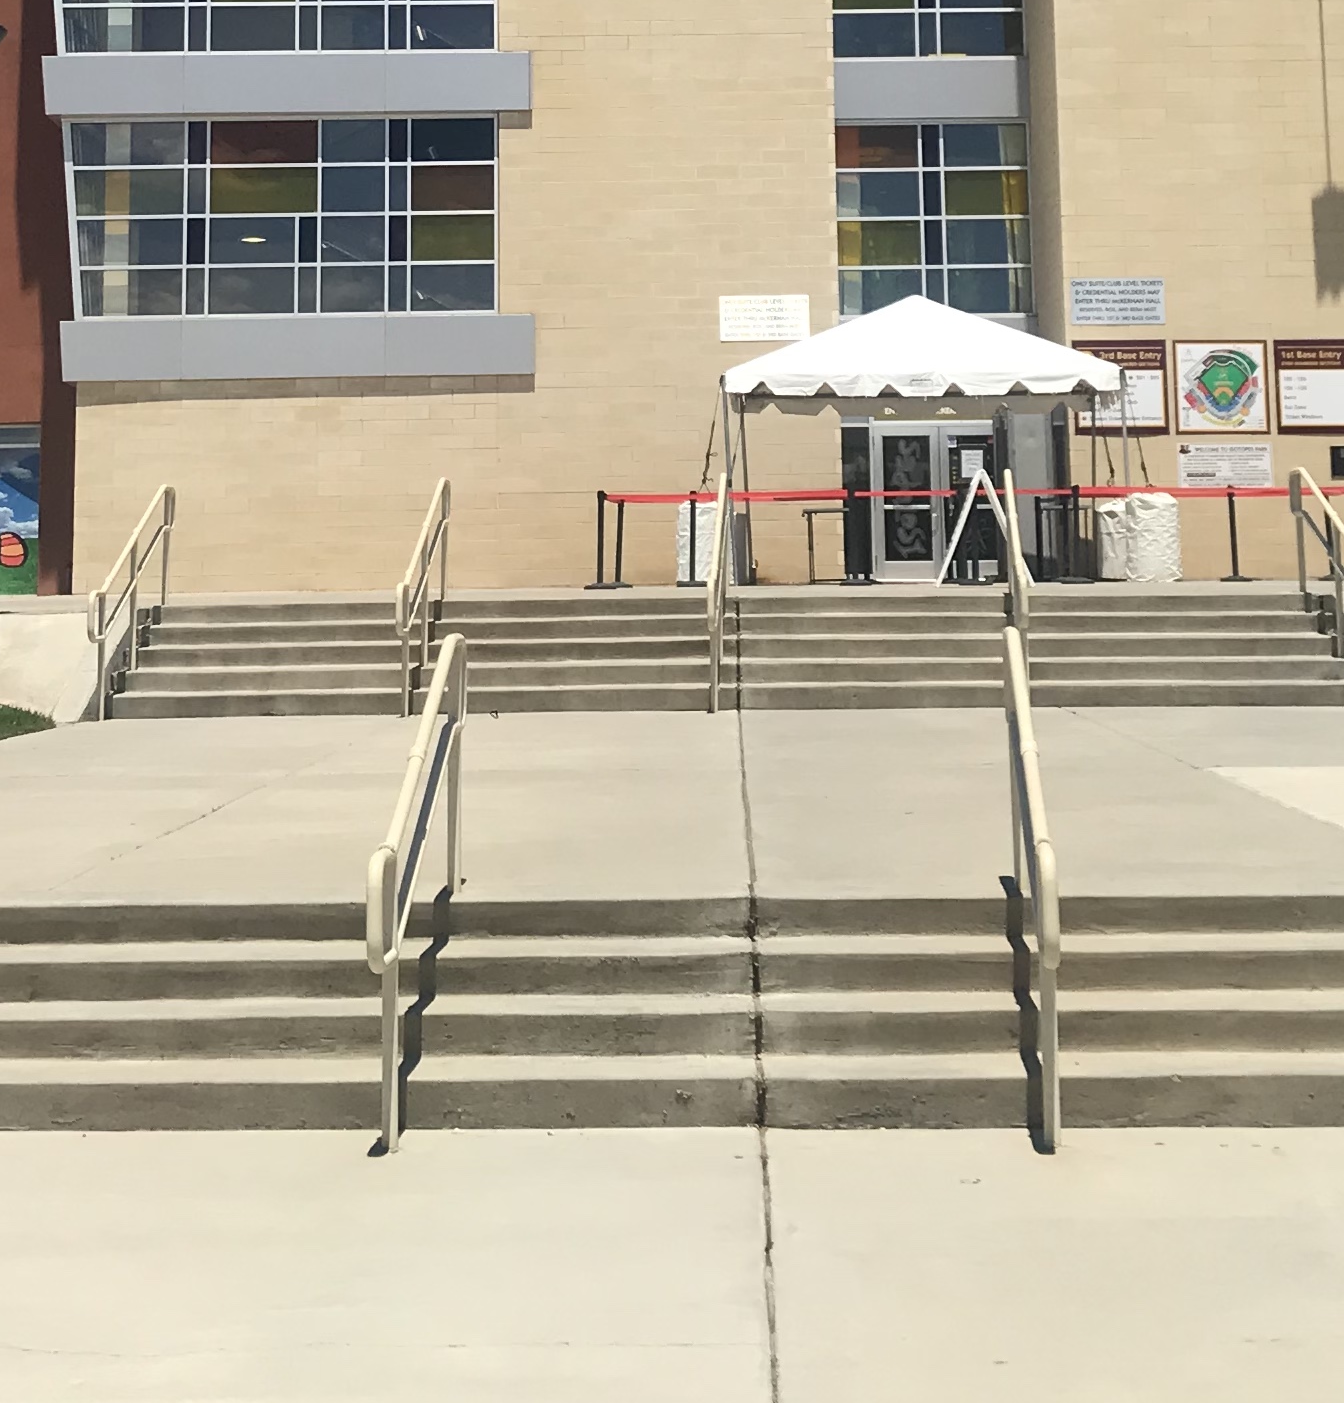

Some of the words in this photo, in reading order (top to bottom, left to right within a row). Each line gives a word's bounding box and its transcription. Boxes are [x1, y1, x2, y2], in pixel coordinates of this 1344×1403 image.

[1117, 351, 1137, 360] Base
[1139, 351, 1162, 360] Entry
[1281, 350, 1295, 359] 1st
[1297, 350, 1317, 359] Base
[1319, 350, 1342, 360] Entry
